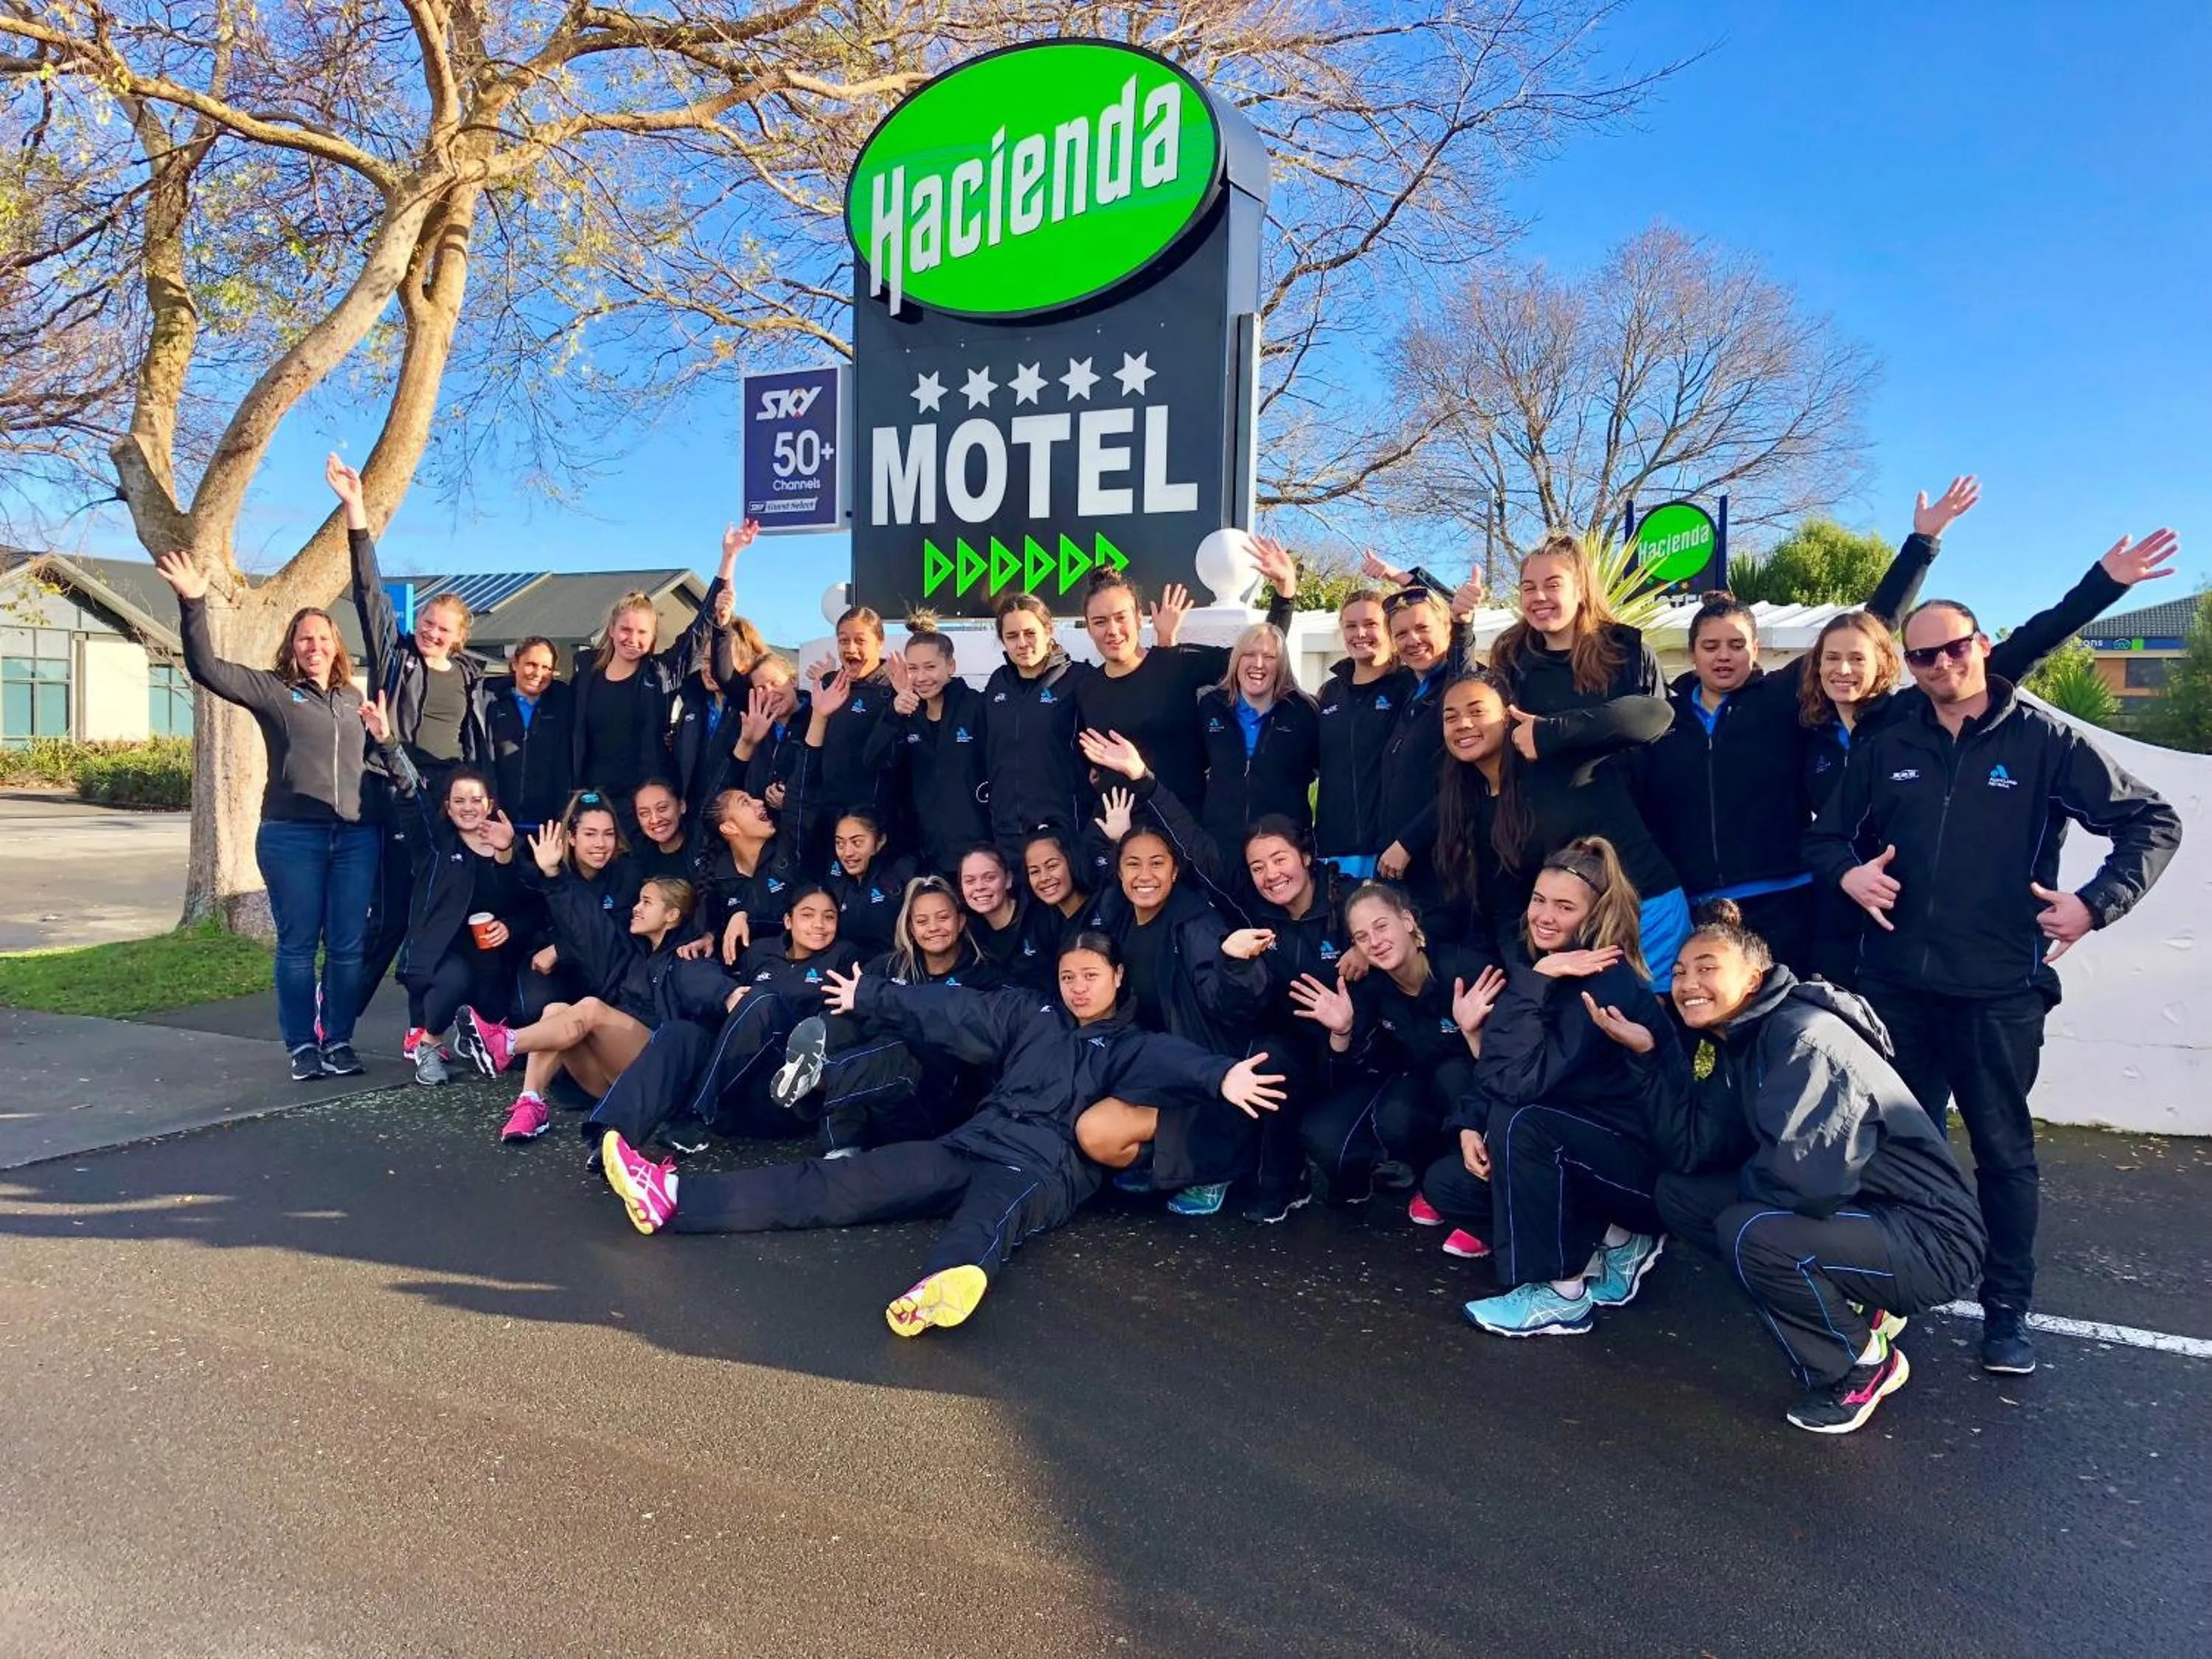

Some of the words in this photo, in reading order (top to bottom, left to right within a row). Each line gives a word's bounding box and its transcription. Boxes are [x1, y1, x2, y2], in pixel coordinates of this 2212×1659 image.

[869, 72, 1182, 316] Hacienda
[755, 386, 823, 421] SKY
[772, 429, 835, 477] 50+
[871, 404, 1199, 526] MOTEL
[772, 478, 821, 492] Channels
[1638, 522, 1711, 567] Hacienda
